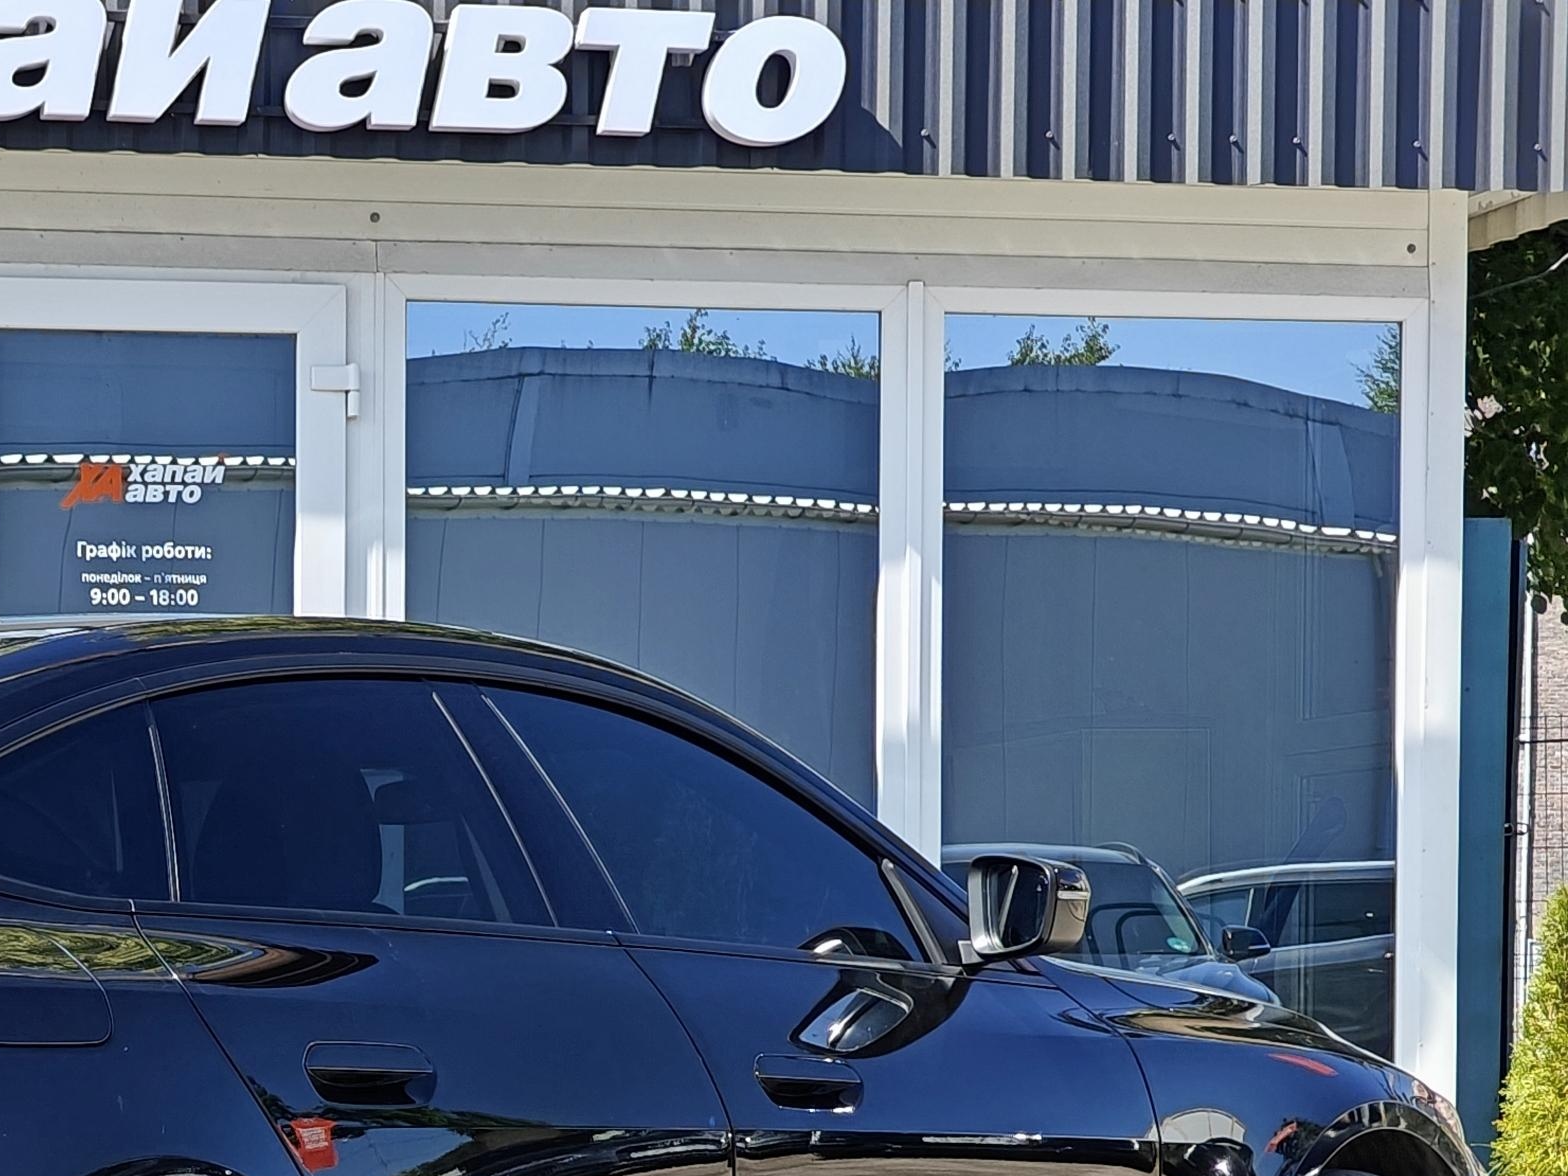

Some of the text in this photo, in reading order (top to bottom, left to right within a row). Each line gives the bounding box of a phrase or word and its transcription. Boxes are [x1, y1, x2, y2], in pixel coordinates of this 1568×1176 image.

[125, 483, 201, 504] авто
[77, 541, 212, 562] Графік роботи:
[82, 571, 142, 584] понеділок
[90, 587, 131, 605] 9:00
[149, 588, 199, 606] 18:00
